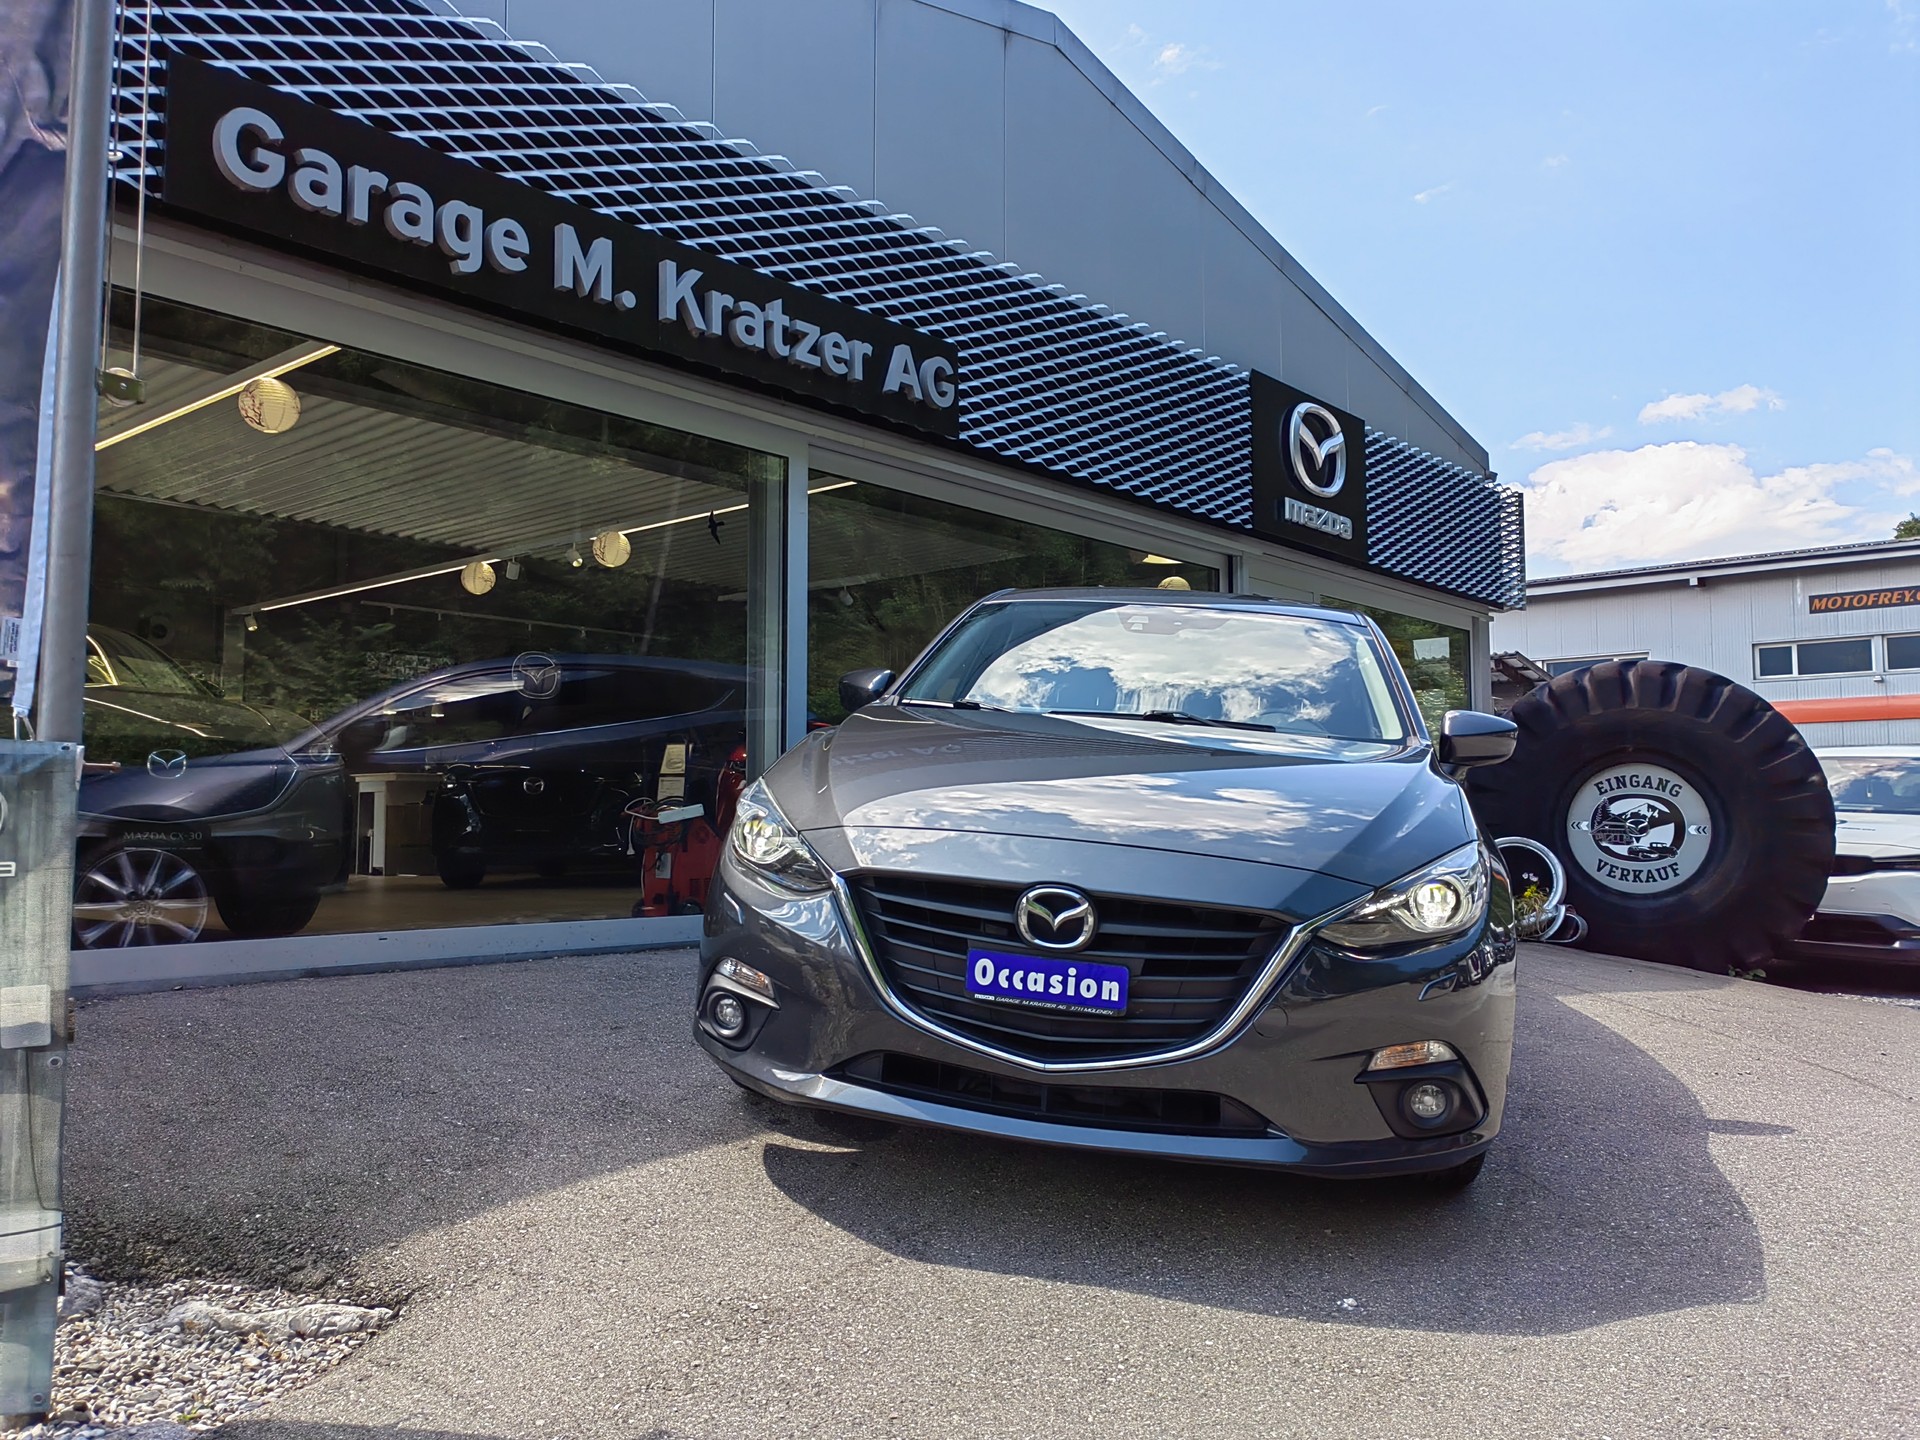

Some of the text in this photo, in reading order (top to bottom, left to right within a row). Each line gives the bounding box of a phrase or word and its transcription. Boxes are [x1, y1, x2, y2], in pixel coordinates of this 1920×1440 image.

[212, 106, 955, 409] Garage M. Kratzer AG
[1284, 496, 1353, 540] mazda
[1593, 774, 1683, 798] EINGANG
[123, 831, 202, 840] MAZDA CX-30
[1595, 858, 1680, 883] VERKAUF
[974, 957, 1120, 1002] Occasion
[996, 996, 1021, 1005] GARAGE
